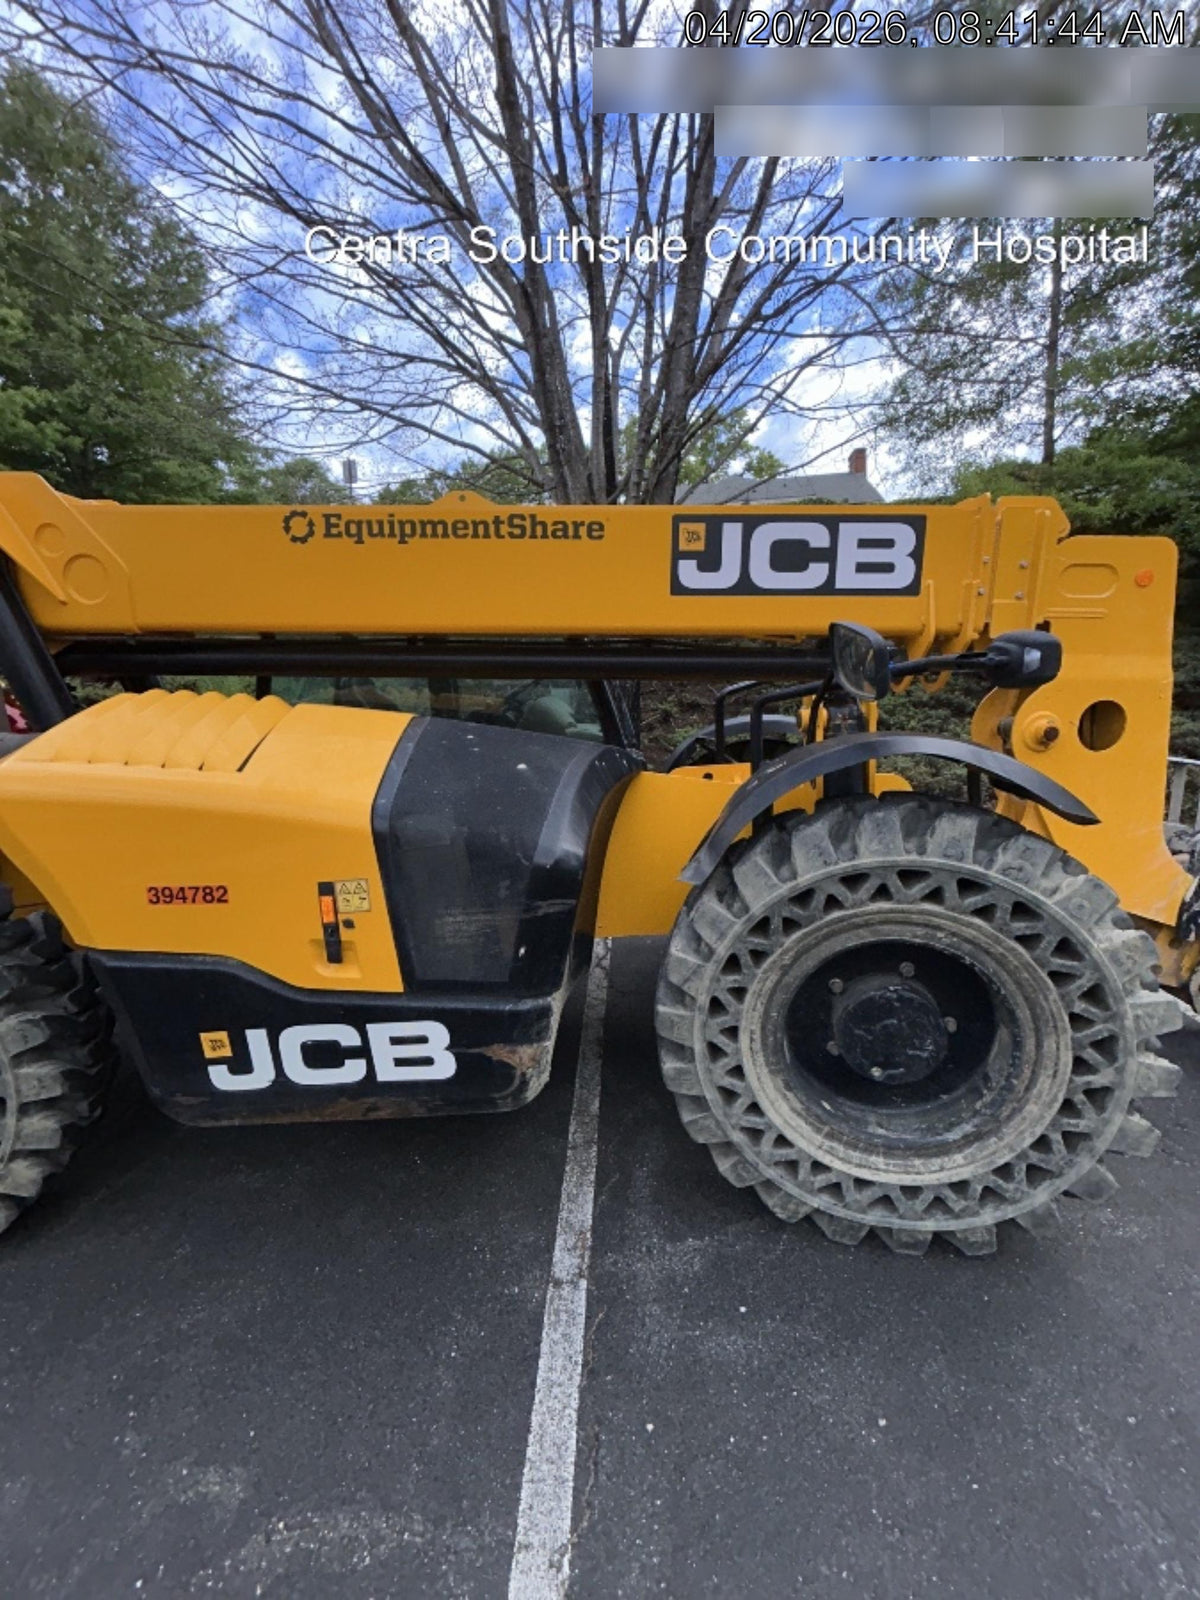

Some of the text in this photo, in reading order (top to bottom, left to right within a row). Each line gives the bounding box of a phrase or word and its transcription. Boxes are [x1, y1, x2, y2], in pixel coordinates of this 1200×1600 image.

[322, 513, 606, 545] EquipmentShare
[677, 522, 917, 589] JCB
[147, 885, 229, 905] 394782
[207, 1020, 458, 1091] JCB
